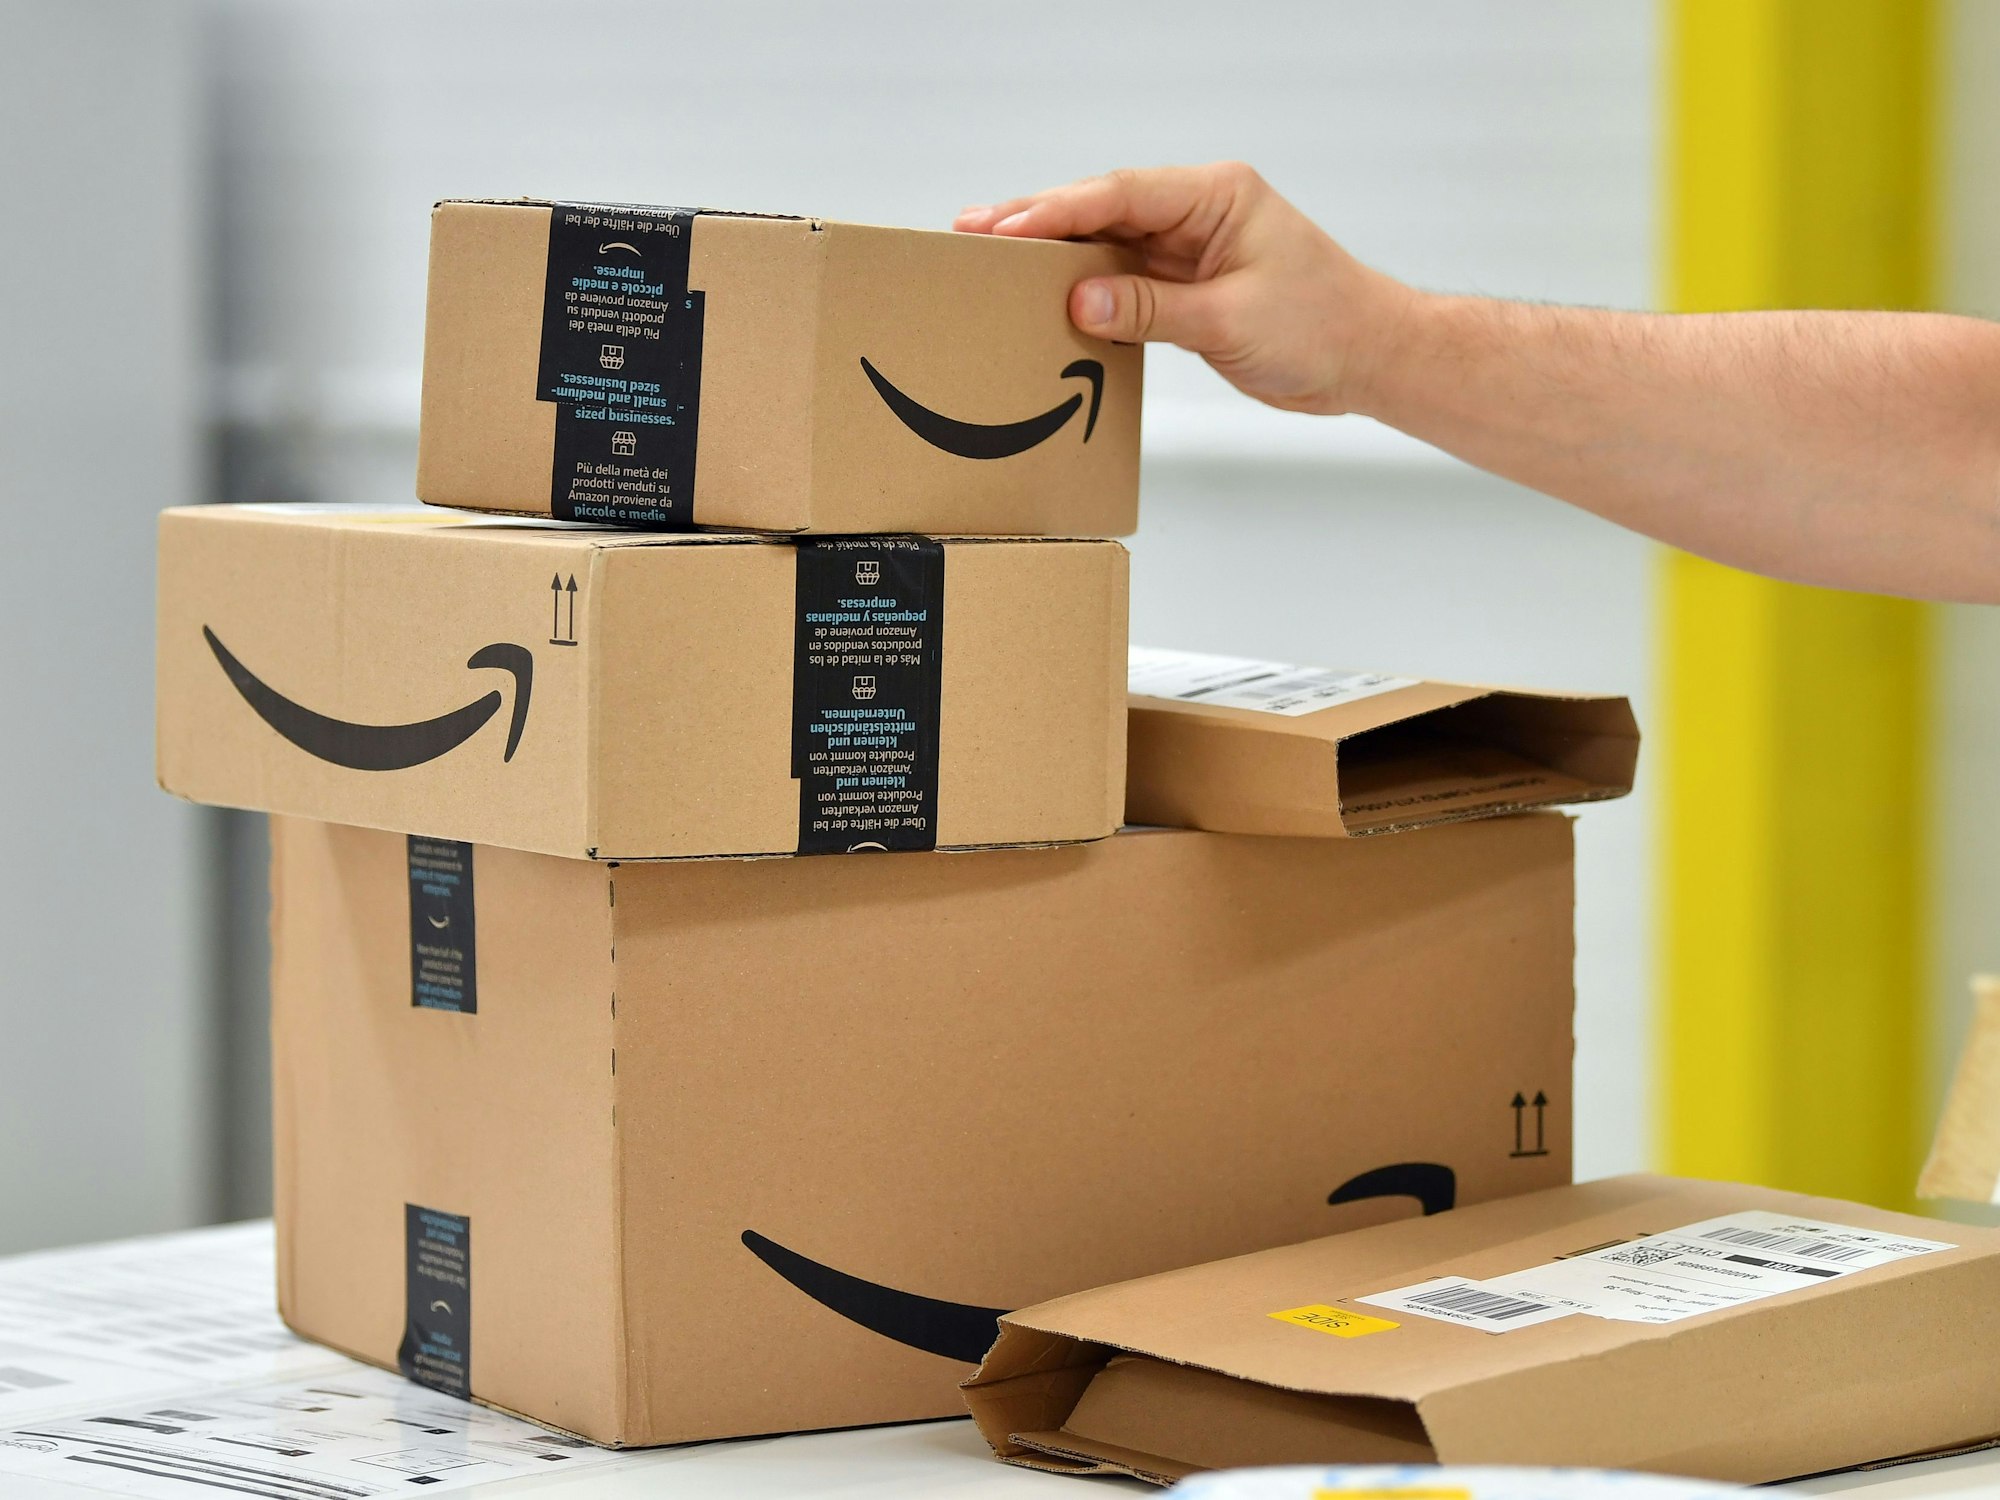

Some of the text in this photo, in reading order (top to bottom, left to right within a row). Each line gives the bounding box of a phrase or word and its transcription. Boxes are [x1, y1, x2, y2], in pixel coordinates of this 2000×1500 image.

[565, 214, 680, 238] Über die Hälfte der bei
[593, 266, 645, 283] imprese.
[572, 278, 609, 289] medie
[622, 283, 663, 298] piccole
[565, 292, 668, 312] Amazon proviene da
[567, 306, 664, 324] prodotti venduti su
[569, 320, 659, 340] Più della metà dei
[561, 373, 660, 395] sized businesses.
[551, 387, 667, 408] small and medium-
[575, 408, 675, 425] sized businesses.
[577, 462, 668, 479] Più della metà dei
[573, 477, 670, 494] prodotti venduti su
[568, 490, 672, 508] Amazon proviene da
[575, 505, 666, 521] piccole e medie
[837, 540, 869, 551] moitié
[899, 541, 919, 551] Plus
[838, 596, 896, 608] empresas.
[806, 609, 927, 625] pequeñas y medianas
[815, 627, 917, 638] Amazon proviene de
[809, 639, 922, 652] productos vendidos en
[810, 654, 920, 666] Más de la mitad de los
[821, 708, 905, 720] Unternehmen.
[811, 722, 915, 734] mittelständischen
[828, 736, 897, 749] kleinen und
[810, 750, 914, 762] Produkte kommt von
[814, 764, 912, 775] Amazon verkauften
[836, 777, 905, 790] kleinen und
[818, 791, 923, 801] Produkte kommt von
[822, 804, 919, 815] Amazon verkauften
[814, 817, 926, 831] Über die Hälfte der bei
[1678, 1243, 1723, 1257] CYCLE
[1293, 1312, 1350, 1329] SIDE
